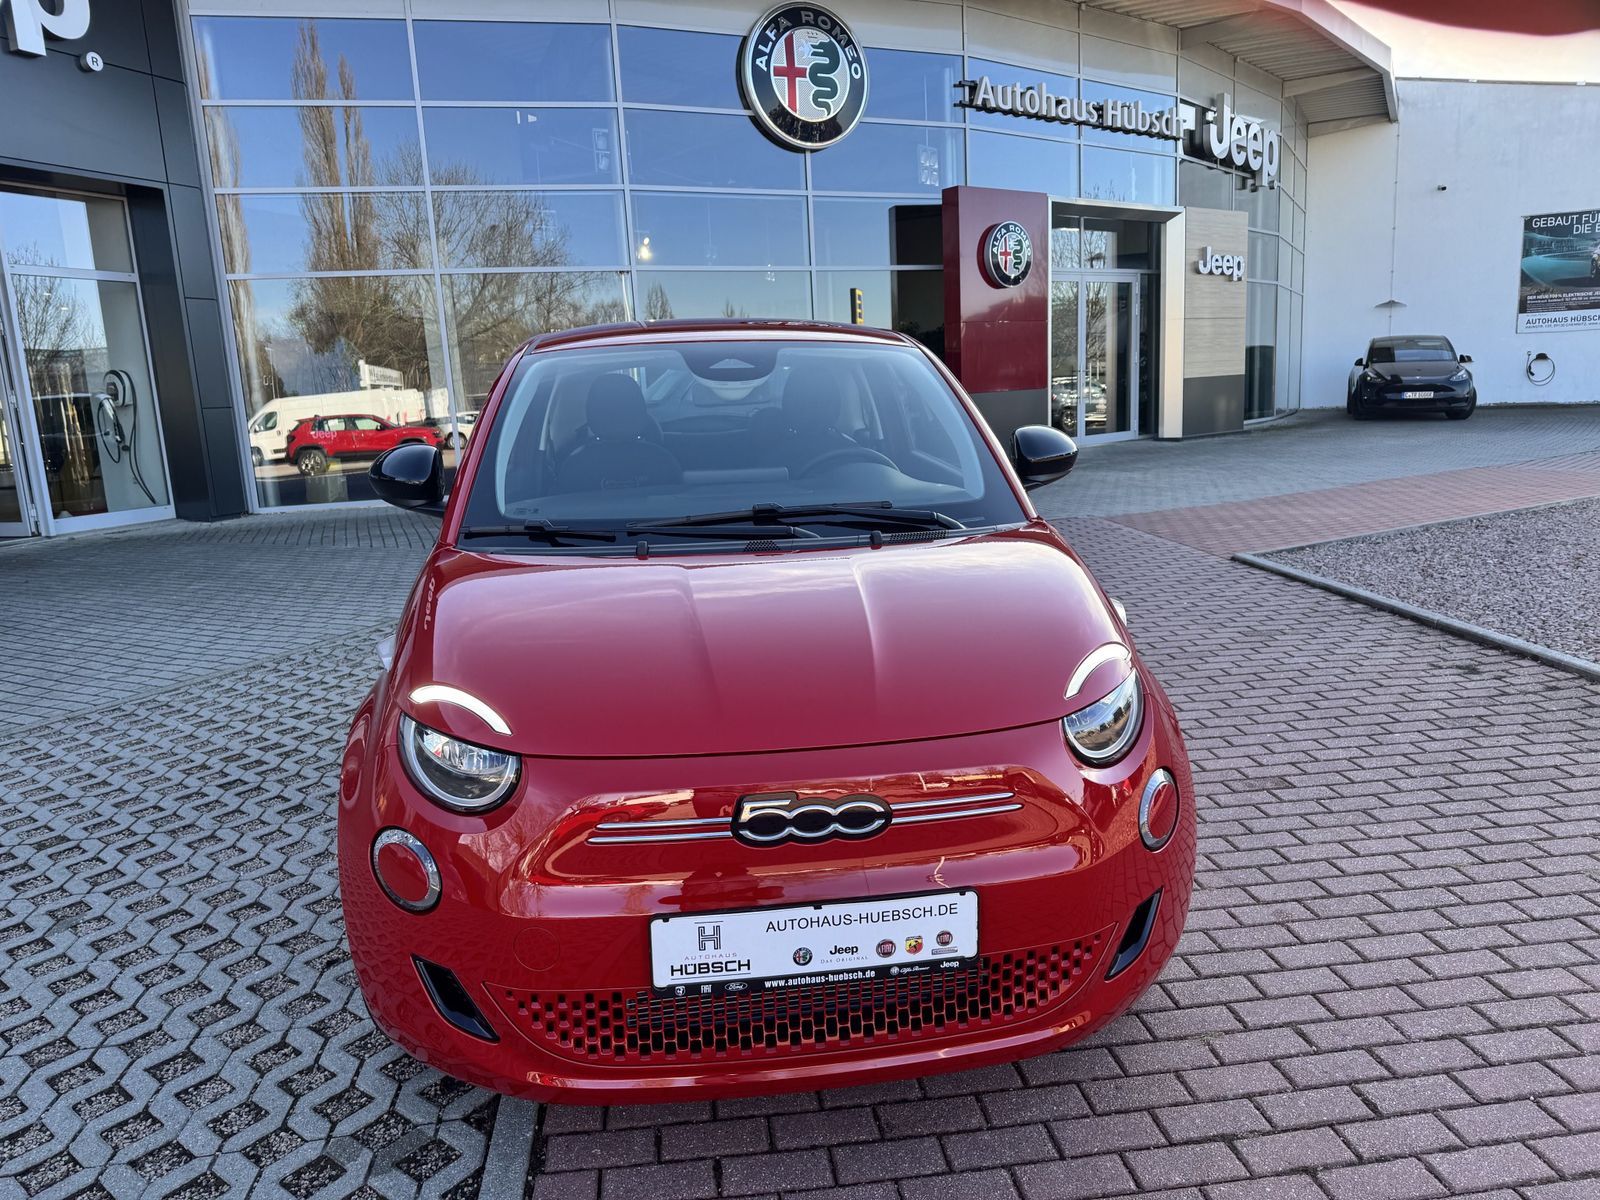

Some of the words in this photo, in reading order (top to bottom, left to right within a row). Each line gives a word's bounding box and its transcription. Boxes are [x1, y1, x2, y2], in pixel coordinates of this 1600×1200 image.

[755, 16, 793, 72] ALFA
[800, 10, 862, 80] ROMEO
[976, 76, 1099, 124] Autohaus
[1104, 98, 1184, 140] Hübsch
[1208, 92, 1279, 187] Jeep
[1532, 214, 1580, 228] GEBAUT
[1573, 223, 1592, 235] DIE
[992, 228, 1007, 254] ALFA
[1009, 224, 1031, 256] ROMEO
[1198, 245, 1245, 281] Jeep
[1526, 316, 1568, 326] AUTOHAUS
[738, 800, 886, 842] 500
[766, 903, 958, 933] AUTOHAUS-HUEBSCH.DE
[940, 934, 950, 943] FIAT
[829, 945, 859, 955] Jeep
[881, 943, 892, 953] FIAT
[684, 952, 738, 961] AUTOHAUS
[671, 959, 751, 976] HÜBSCH
[728, 982, 744, 991] Ford
[764, 970, 876, 988] www.autohaus-huebsch.de
[701, 985, 712, 993] FIAT
